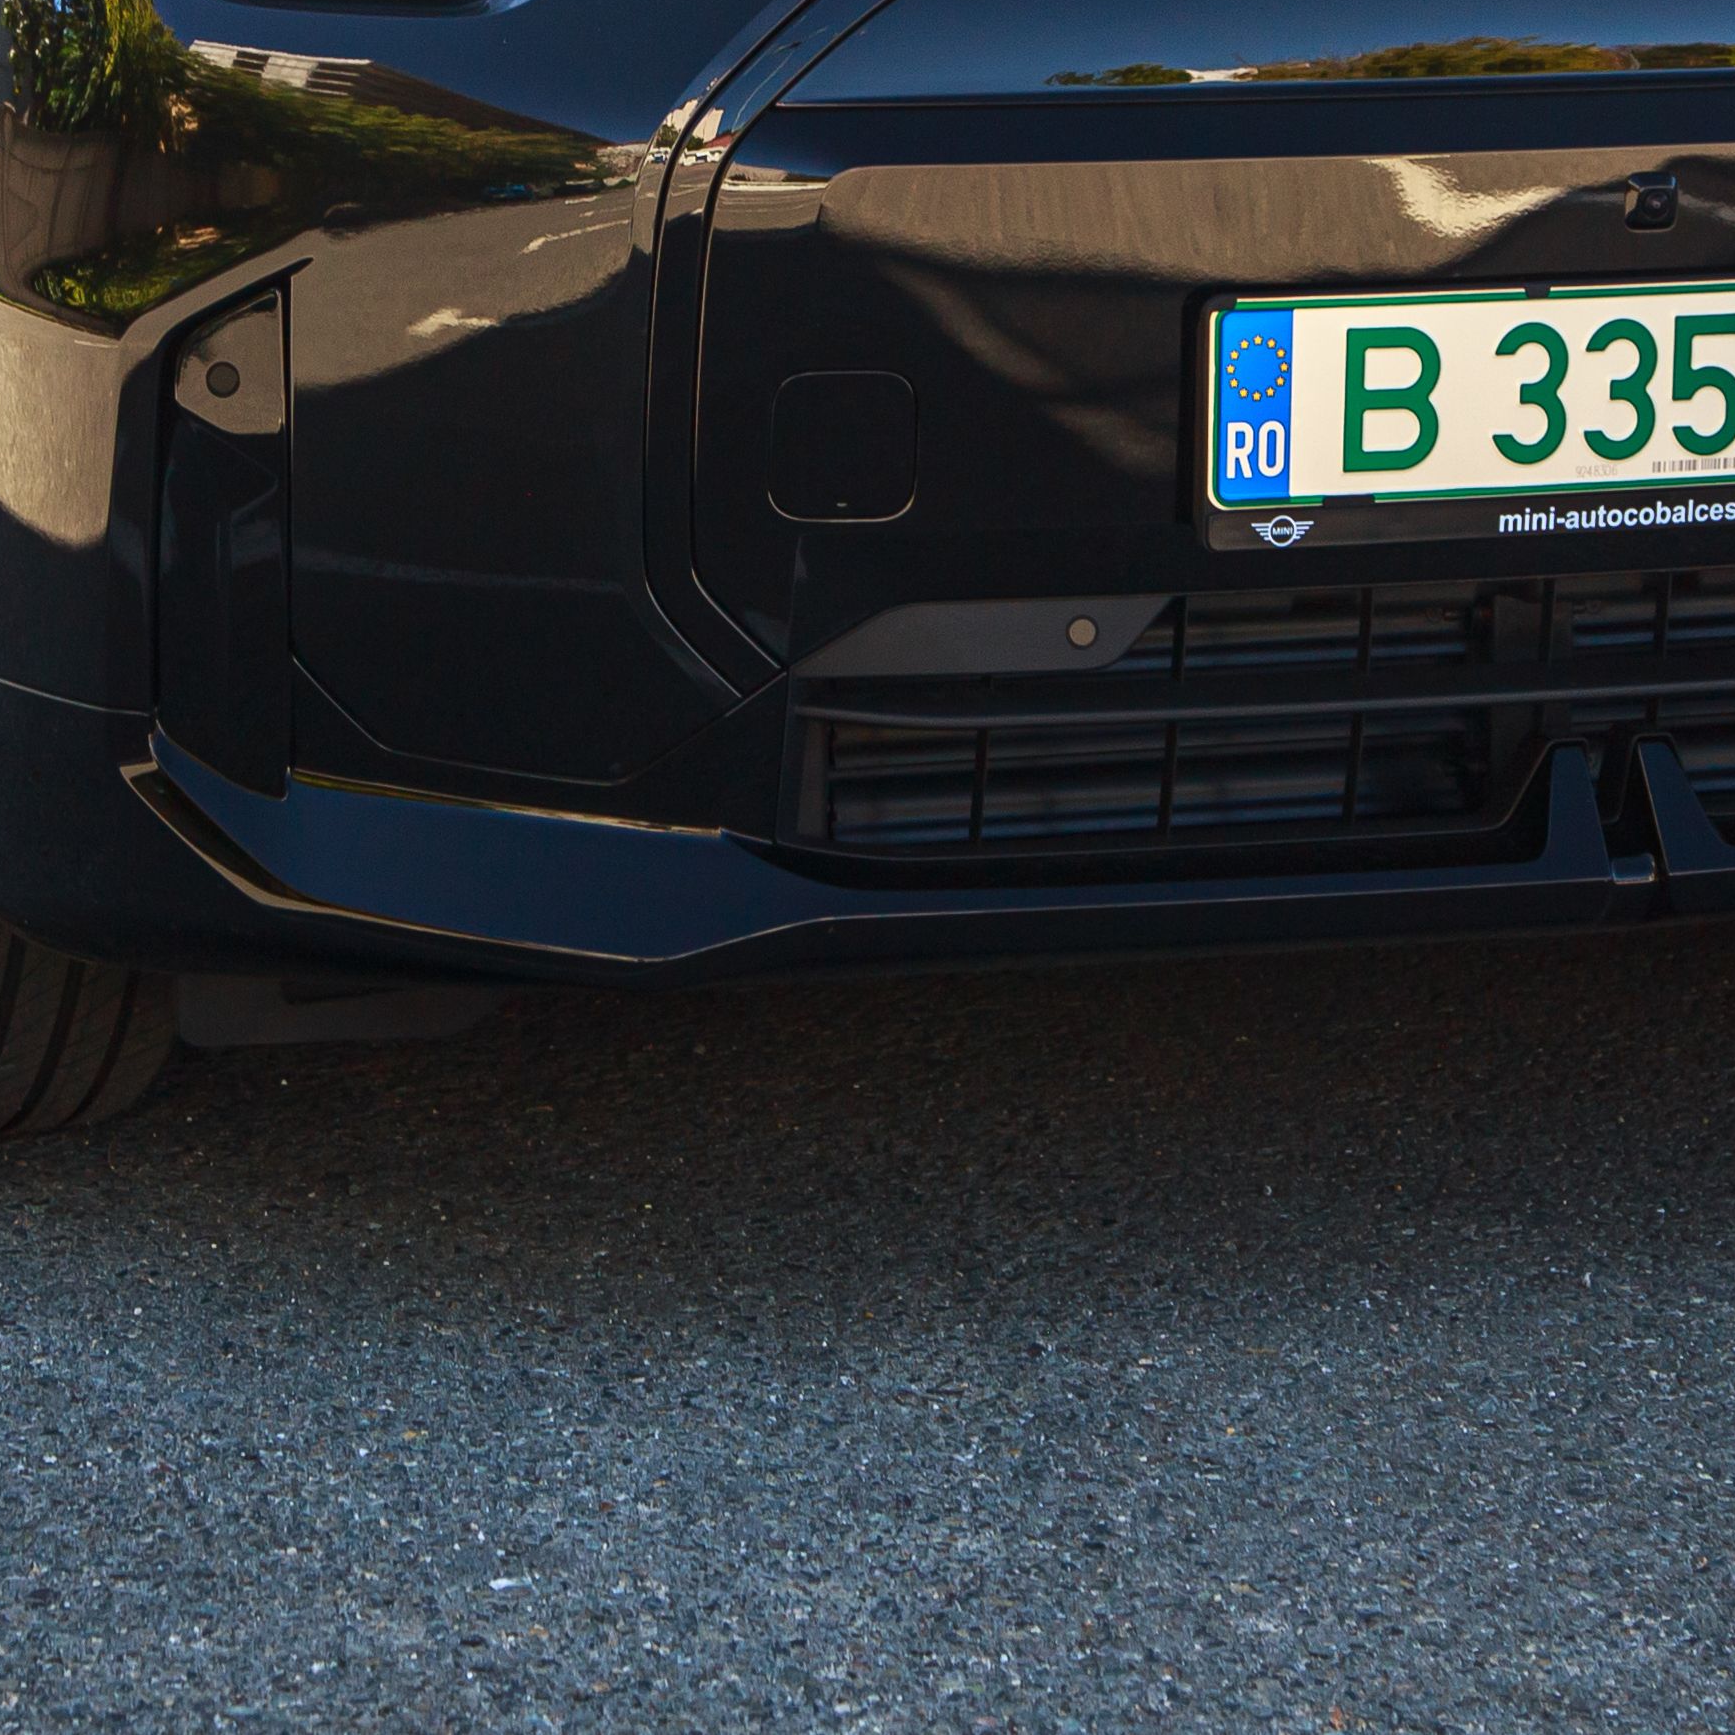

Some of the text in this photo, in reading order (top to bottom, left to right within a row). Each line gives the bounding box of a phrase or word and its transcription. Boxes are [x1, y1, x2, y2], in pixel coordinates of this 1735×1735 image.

[1342, 325, 1442, 474] B
[1226, 420, 1286, 479] RO
[1272, 526, 1294, 536] MINI
